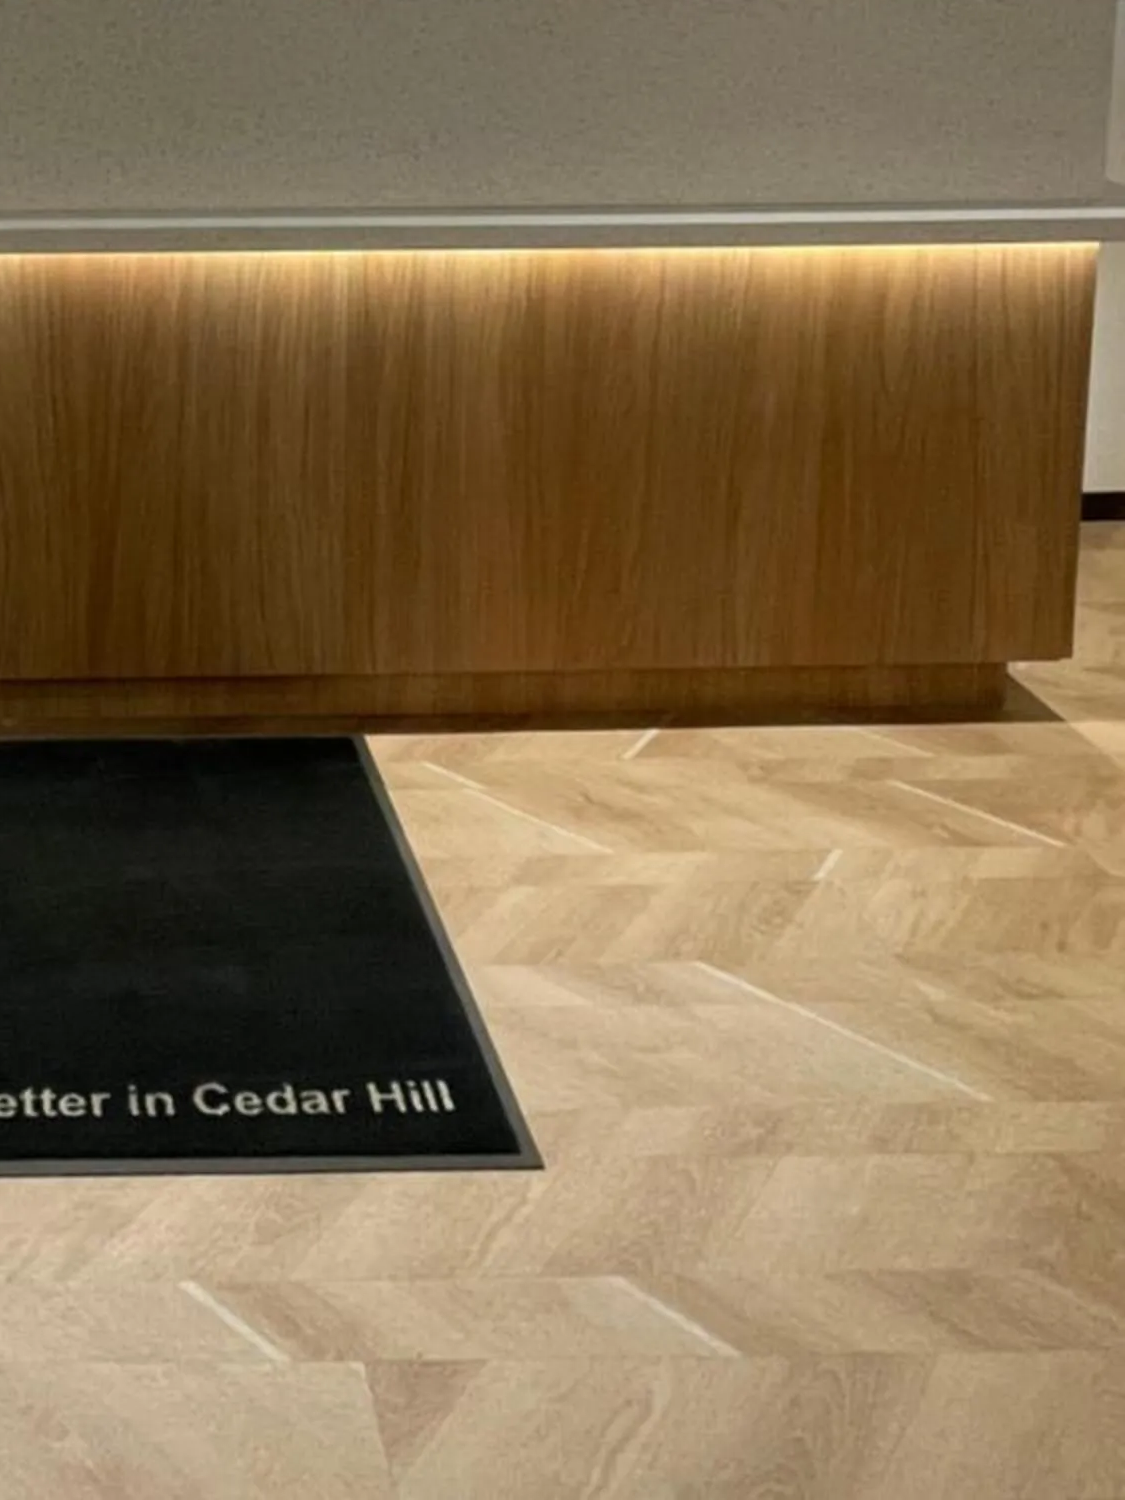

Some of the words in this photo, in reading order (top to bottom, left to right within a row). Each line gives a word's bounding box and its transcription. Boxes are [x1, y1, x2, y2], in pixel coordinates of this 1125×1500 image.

[129, 1085, 175, 1116] in
[193, 1083, 349, 1115] Cedar
[367, 1080, 454, 1113] Hill
